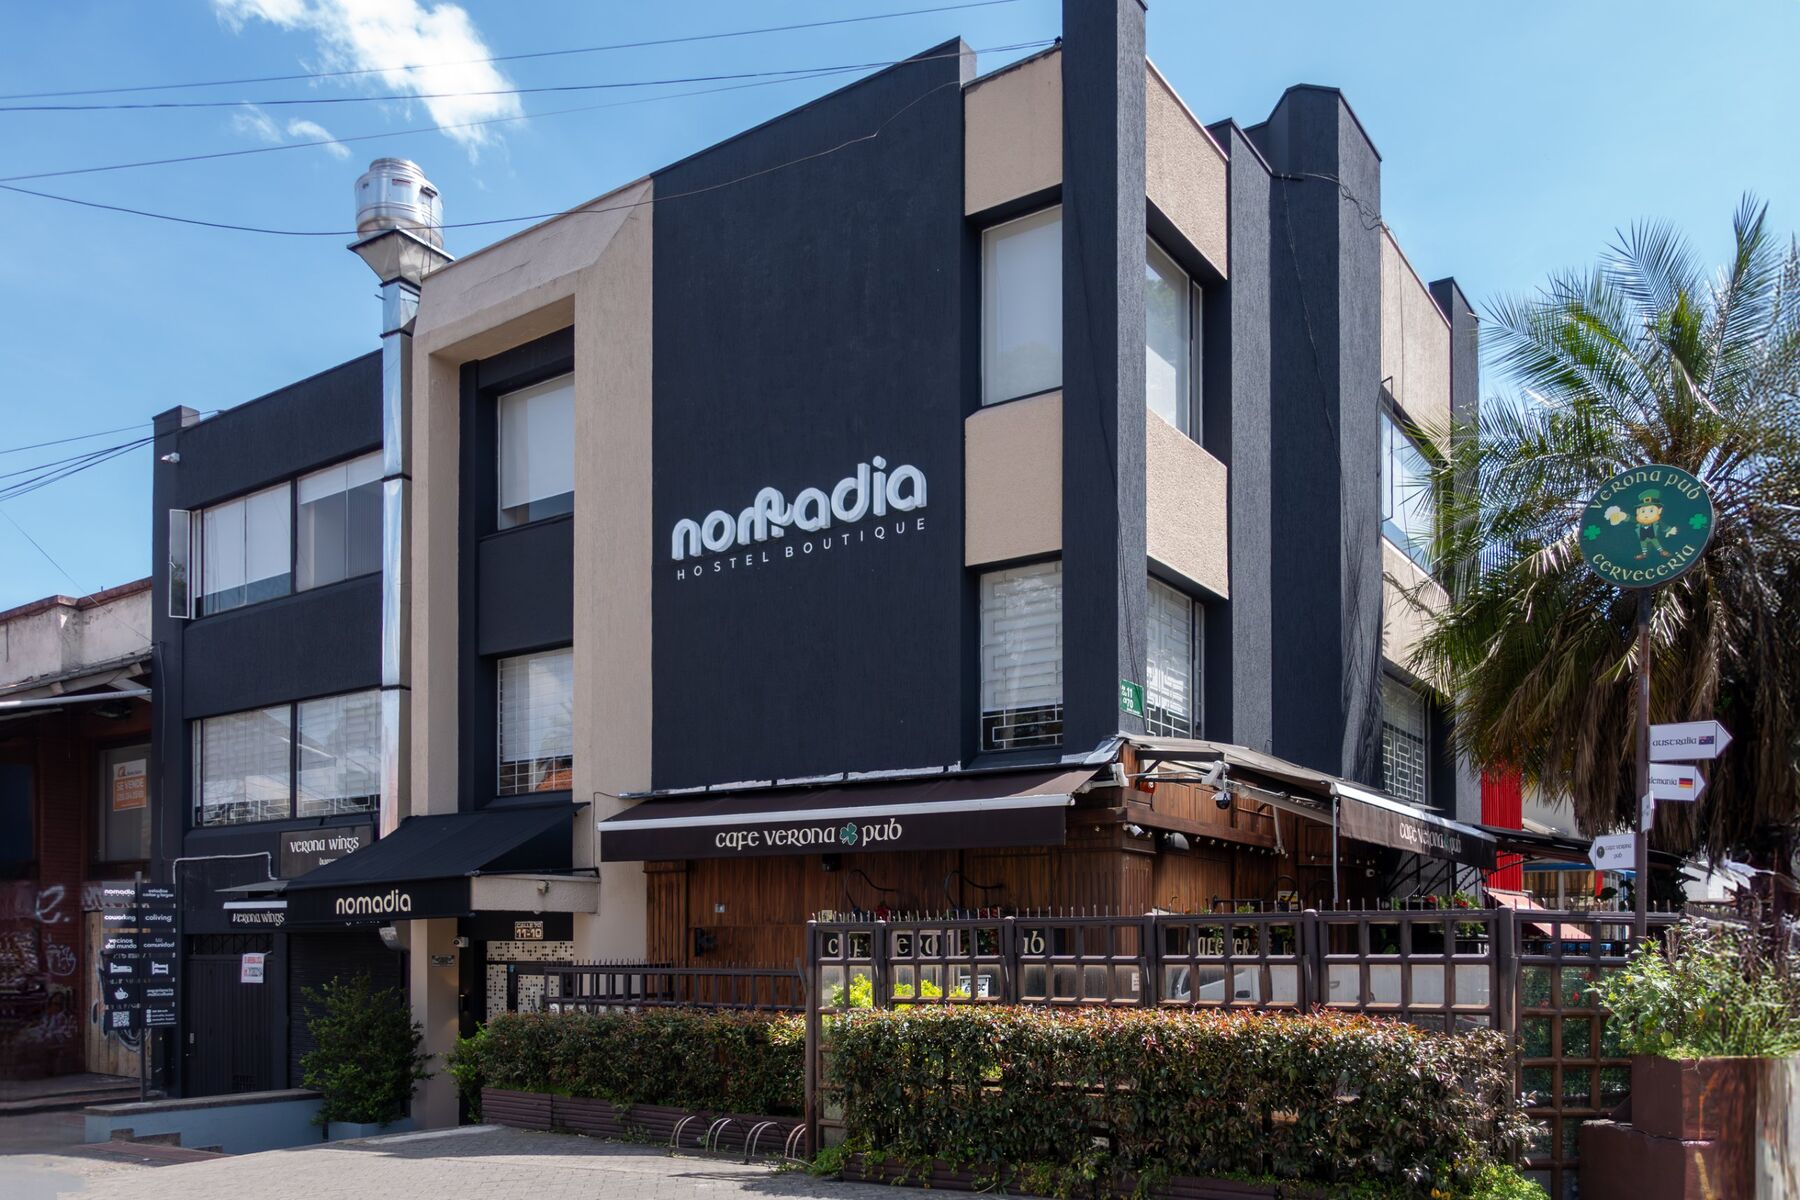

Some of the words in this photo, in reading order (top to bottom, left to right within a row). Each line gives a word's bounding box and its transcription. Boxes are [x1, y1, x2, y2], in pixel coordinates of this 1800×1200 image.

[671, 455, 927, 561] nomadia
[676, 551, 769, 581] HOSTEL
[785, 518, 925, 558] BOUTIQUE
[328, 835, 360, 853] wings
[862, 818, 902, 847] pub
[336, 889, 412, 915] nomadia
[145, 914, 172, 922] coliving
